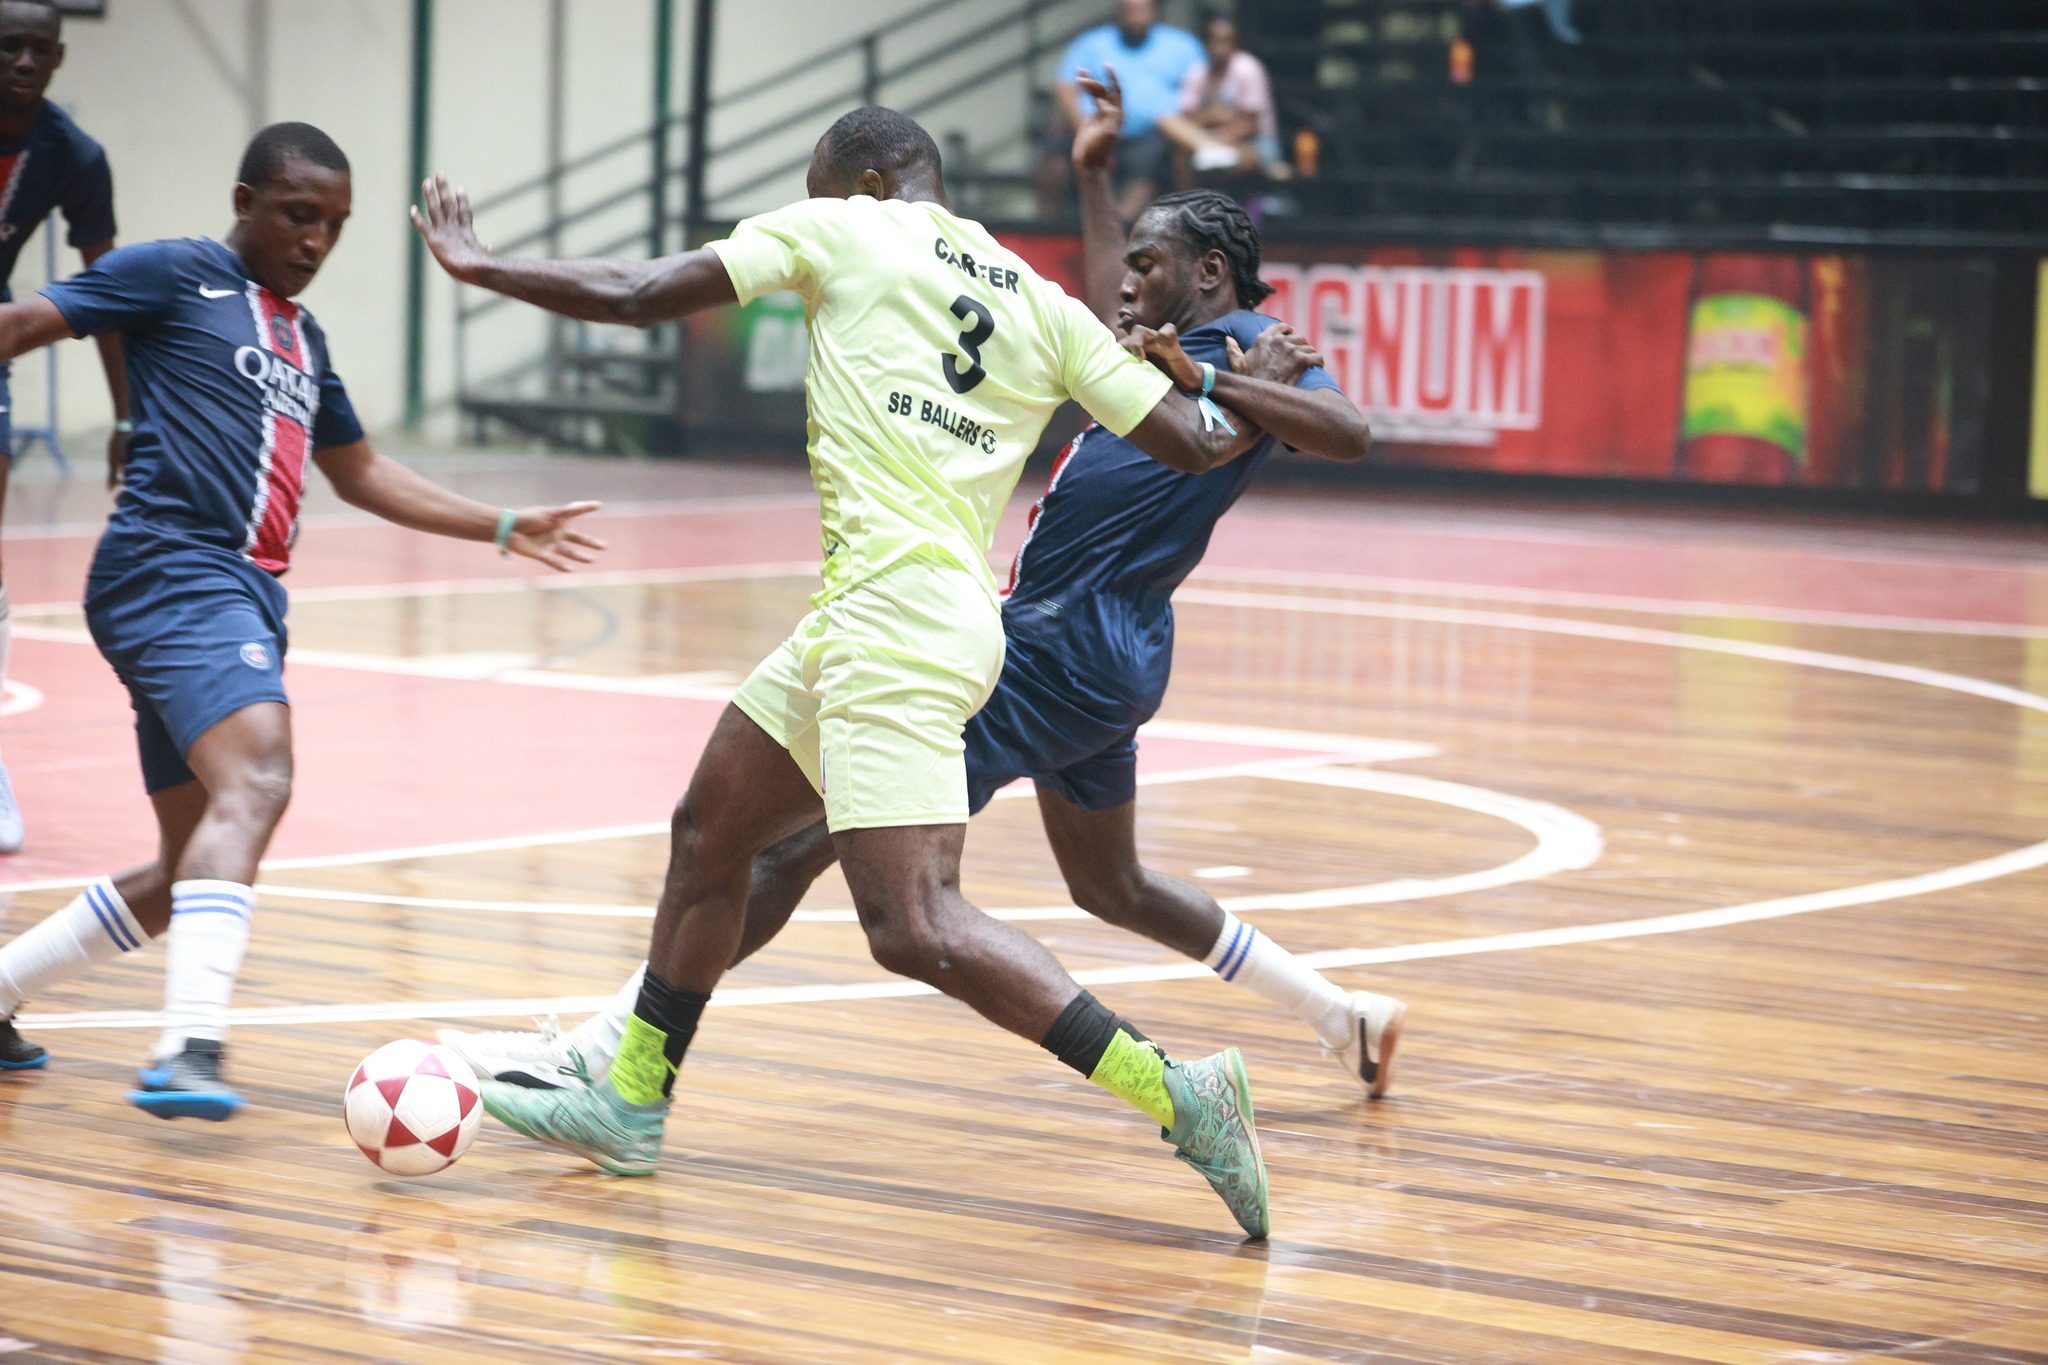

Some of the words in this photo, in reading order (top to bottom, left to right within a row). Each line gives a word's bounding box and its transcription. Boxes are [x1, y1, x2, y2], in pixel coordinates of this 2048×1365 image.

[941, 294, 995, 395] 3
[888, 391, 912, 416] SB
[920, 399, 981, 447] BALLERS
